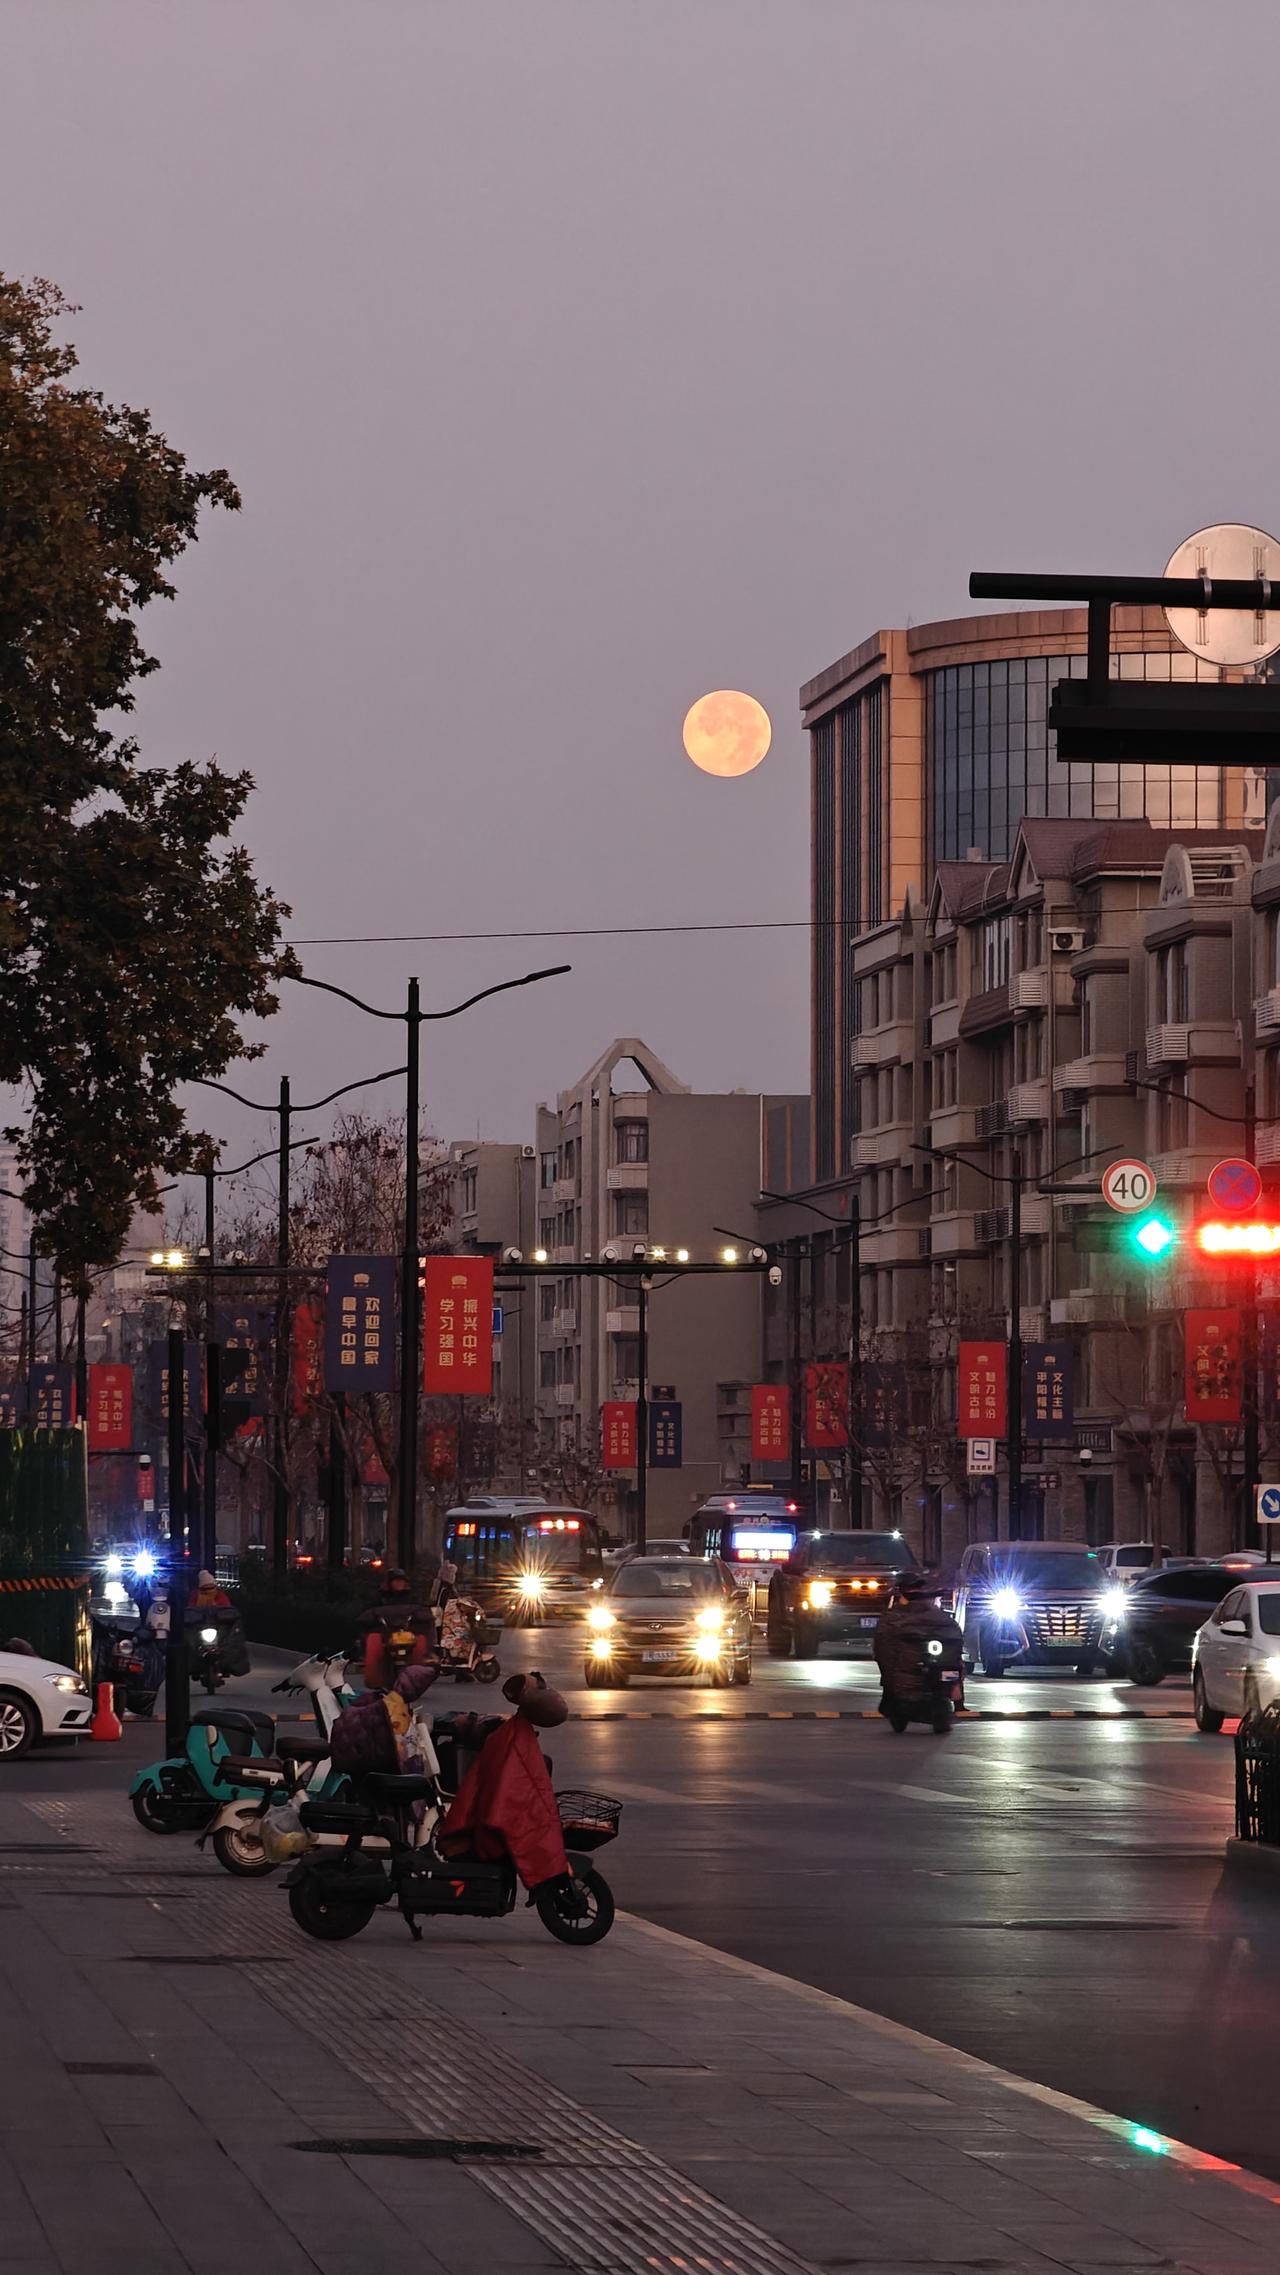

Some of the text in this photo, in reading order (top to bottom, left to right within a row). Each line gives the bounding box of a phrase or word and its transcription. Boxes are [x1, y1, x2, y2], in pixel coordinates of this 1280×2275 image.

[1111, 1173, 1148, 1200] 40
[364, 1297, 380, 1365] 欢迎回家
[439, 1299, 455, 1366] 学习强国
[462, 1299, 478, 1366] 振兴中华
